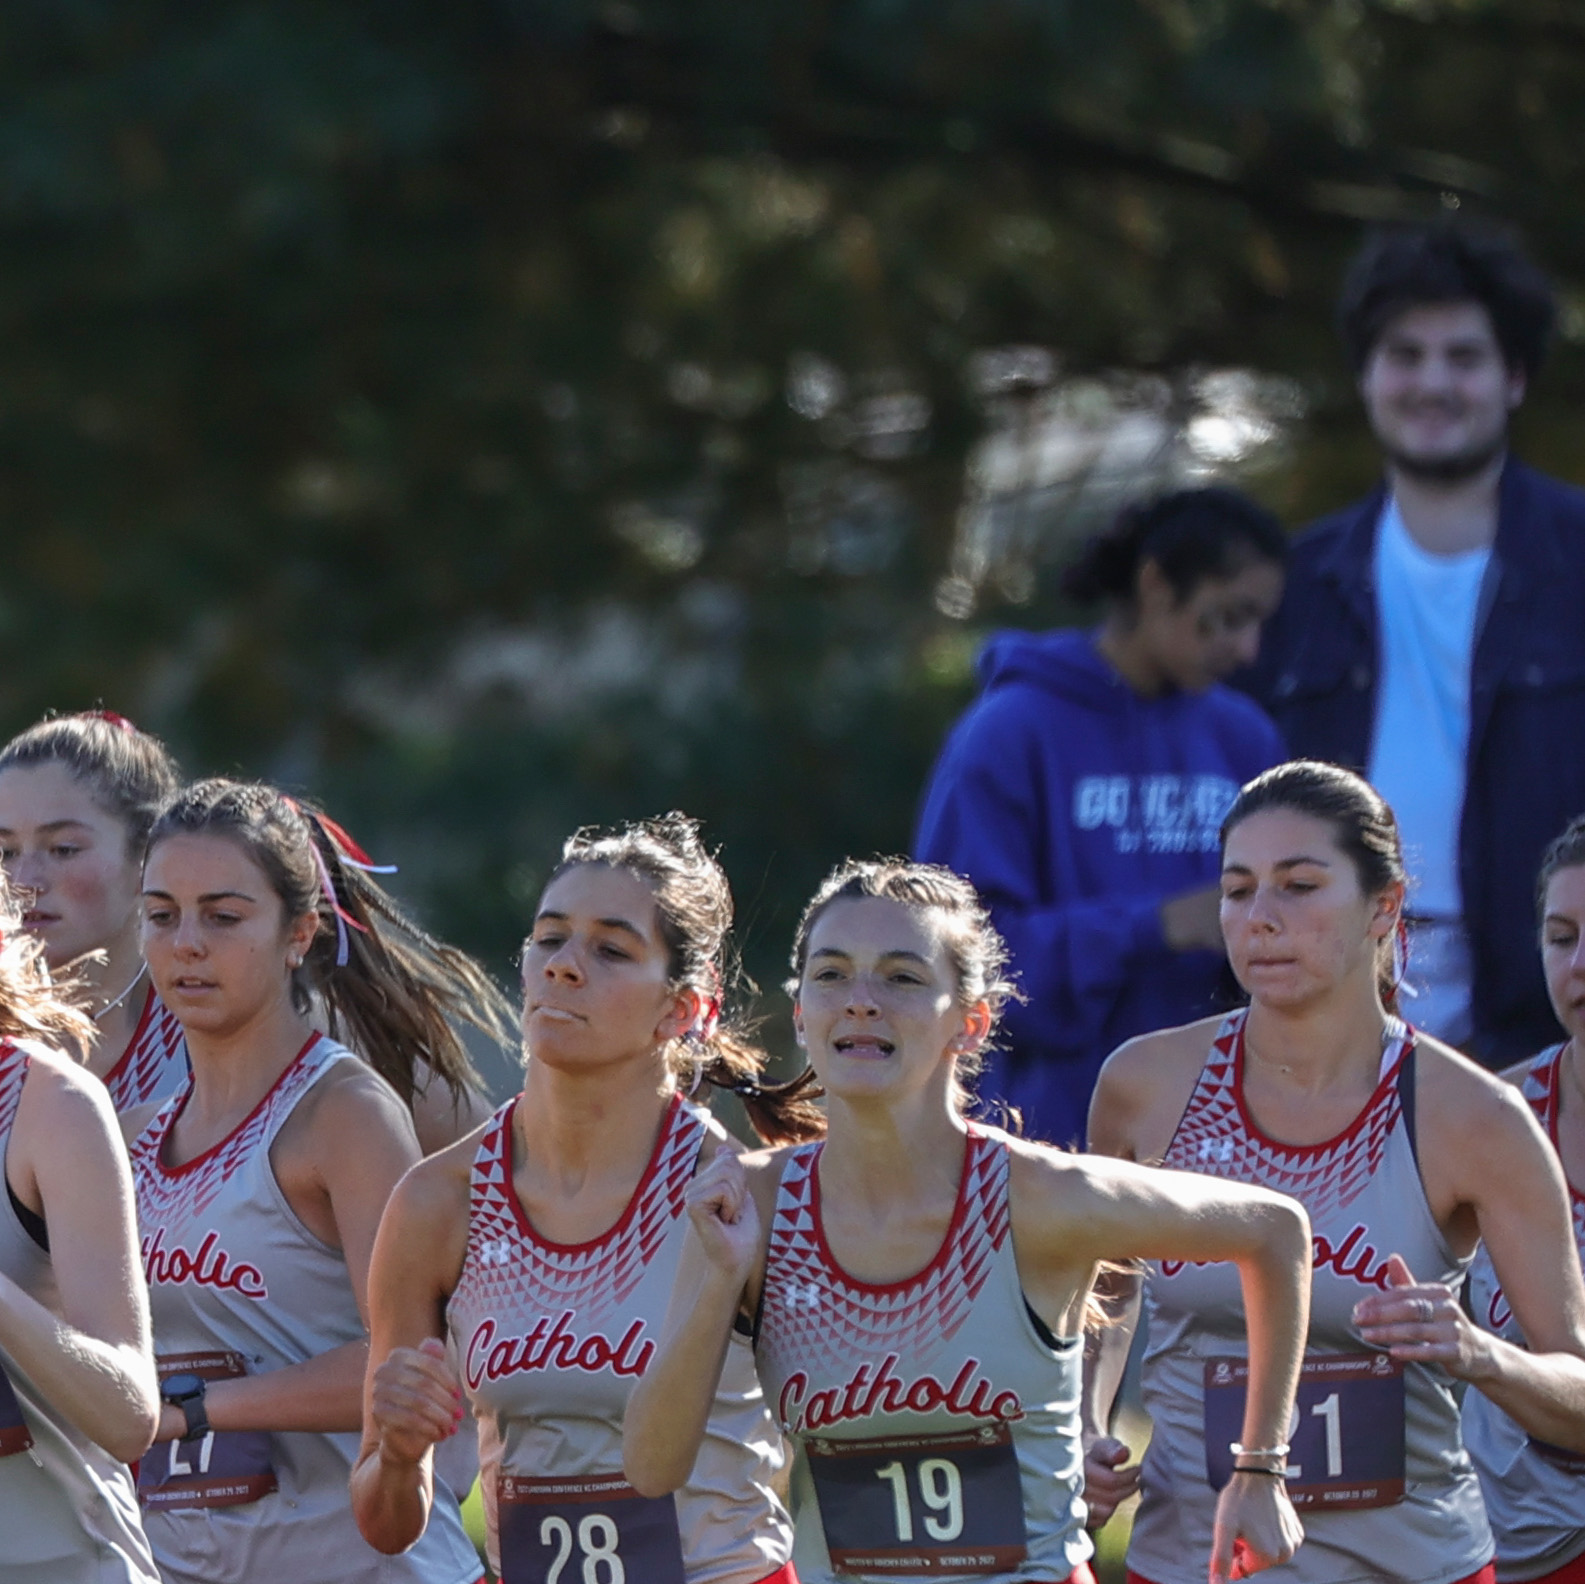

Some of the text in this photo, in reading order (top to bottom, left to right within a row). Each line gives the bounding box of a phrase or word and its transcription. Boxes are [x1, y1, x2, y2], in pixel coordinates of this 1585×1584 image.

[141, 1225, 268, 1300] tholic
[466, 1309, 657, 1391] Catholi
[779, 1353, 1026, 1435] Catholic
[875, 1458, 963, 1541] 19
